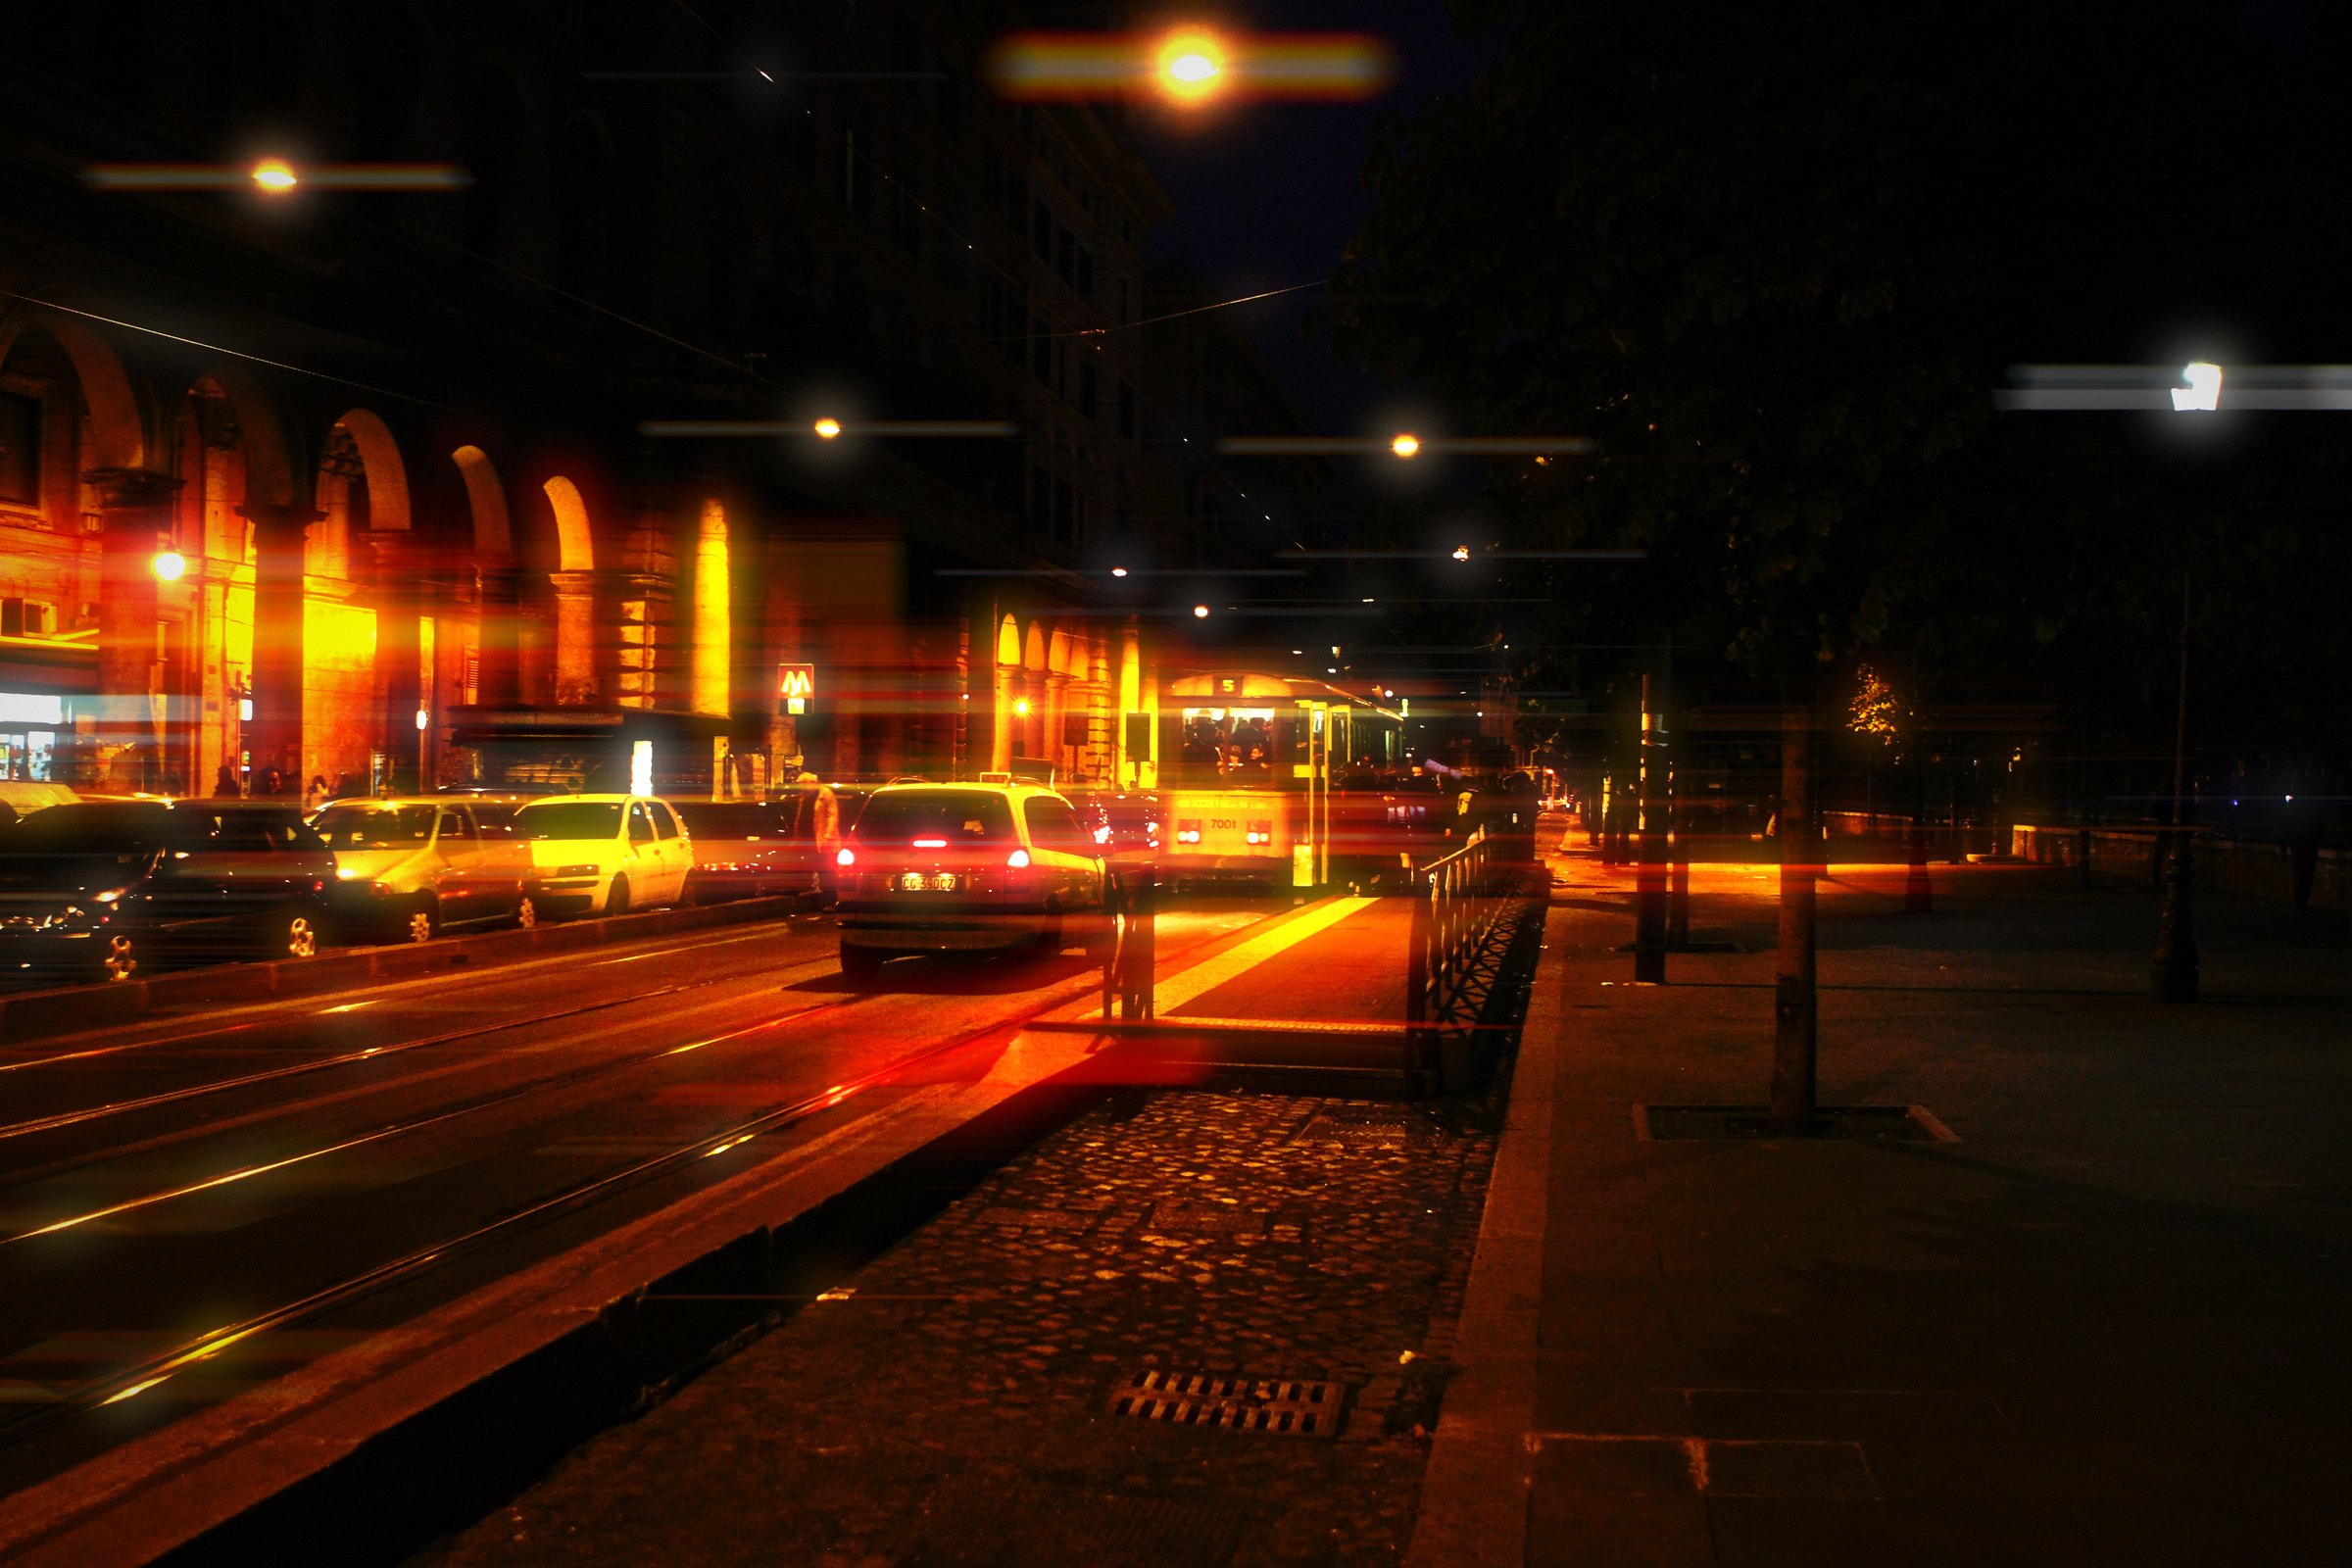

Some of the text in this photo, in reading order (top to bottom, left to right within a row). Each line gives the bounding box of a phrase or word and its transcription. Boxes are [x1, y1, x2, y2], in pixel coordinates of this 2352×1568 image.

[781, 670, 812, 693] M
[1222, 679, 1234, 692] 5
[1210, 818, 1237, 829] 7001
